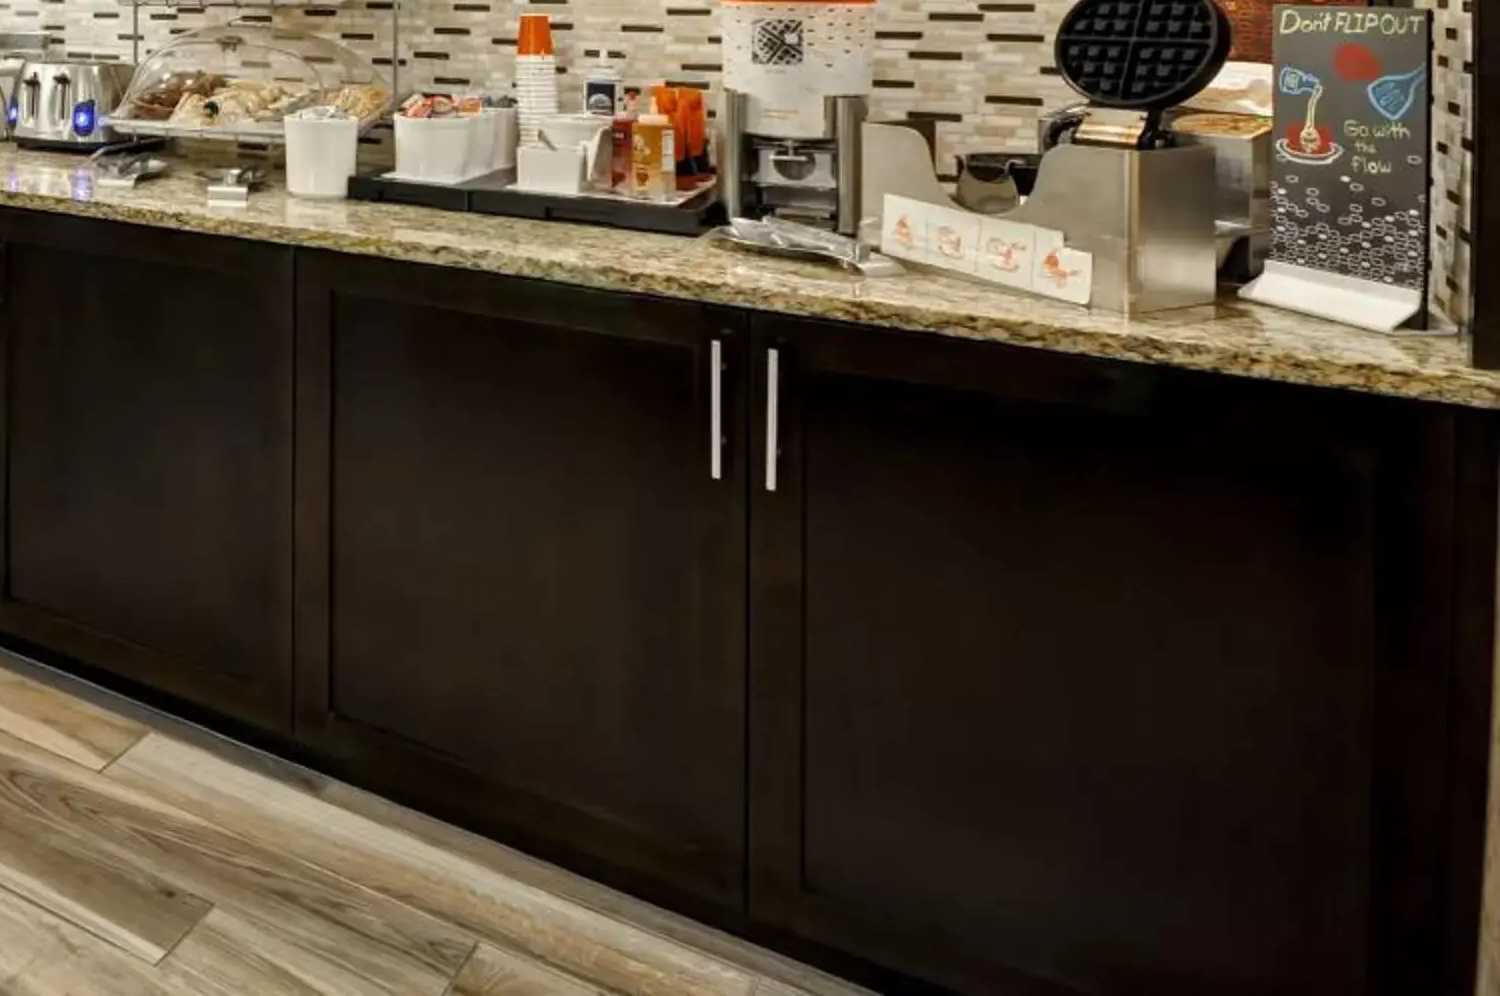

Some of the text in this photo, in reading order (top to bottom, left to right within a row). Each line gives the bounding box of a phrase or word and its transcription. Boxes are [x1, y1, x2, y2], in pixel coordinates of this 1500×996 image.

[1279, 9, 1425, 35] Don't FLIP OUT
[1344, 119, 1411, 140] Go with
[1355, 140, 1378, 155] the
